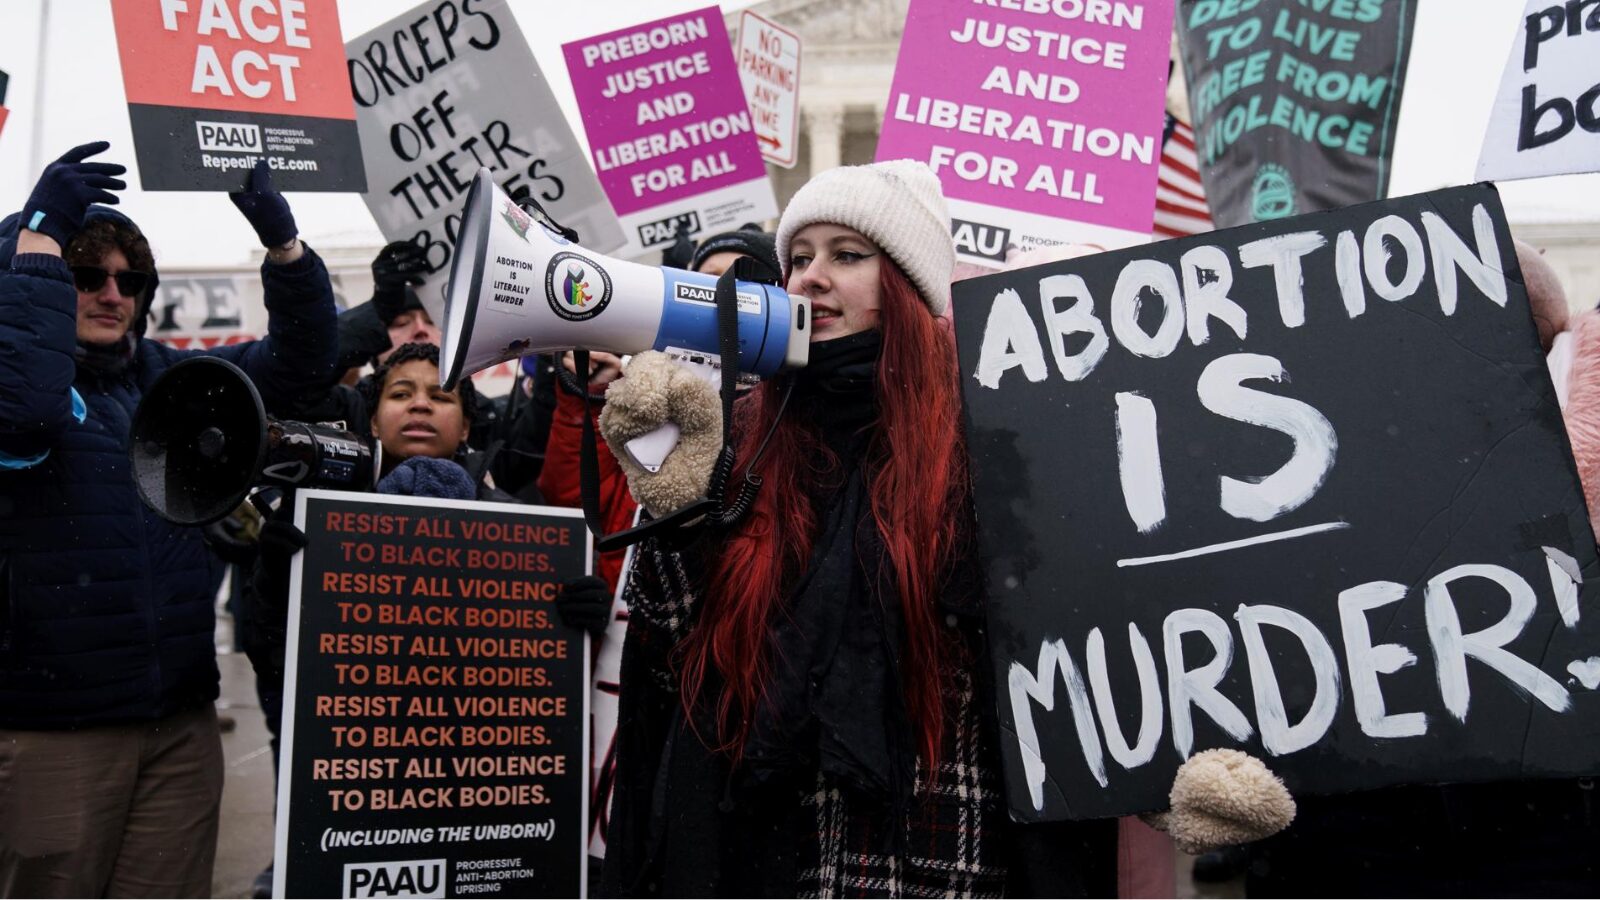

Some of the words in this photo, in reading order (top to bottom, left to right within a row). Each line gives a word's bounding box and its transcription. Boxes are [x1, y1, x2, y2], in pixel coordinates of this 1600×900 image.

[160, 0, 312, 49] FACE
[1206, 17, 1262, 61] TO
[1272, 8, 1362, 61] LIVE
[582, 17, 709, 68] PREBORN
[758, 29, 782, 58] NO
[950, 18, 1127, 70] JUSTICE
[190, 44, 302, 102] ACT
[601, 52, 711, 98] JUSTICE
[743, 48, 794, 92] PARKING
[981, 65, 1080, 104] AND
[1276, 52, 1388, 110] FROM
[637, 92, 695, 126] AND
[754, 84, 781, 108] ANY
[390, 89, 457, 163] OFF
[751, 103, 780, 131] TIME
[893, 93, 1155, 165] LIBERATION
[1205, 93, 1375, 167] VIOLENCE
[201, 126, 257, 148] PAAU
[595, 111, 751, 171] LIBERATION
[201, 154, 318, 173] RepealFCE.com
[631, 163, 687, 198] FOR
[691, 151, 737, 183] ALL
[928, 145, 1019, 188] FOR
[1025, 165, 1104, 205] ALL
[496, 255, 533, 271] ABORTION
[509, 271, 517, 280] IS
[493, 280, 530, 295] LITERALLY
[494, 293, 524, 306] MURDER
[680, 286, 716, 302] PAAU
[974, 202, 1508, 390] ABORTION
[1115, 352, 1339, 534] IS
[325, 511, 409, 537] RESIST
[415, 518, 455, 540] ALL
[459, 521, 570, 546] VIOLENCE
[341, 542, 375, 564] TO
[381, 545, 461, 568] BLACK
[467, 550, 555, 573] BODIES.
[323, 572, 406, 596] RESIST
[412, 575, 453, 598] ALL
[458, 578, 564, 602] VIOLENC
[337, 603, 372, 624] TO
[379, 604, 459, 626] BLACK
[465, 608, 554, 630] BODIES.
[319, 633, 404, 655] RESIST
[409, 636, 450, 657] ALL
[456, 638, 567, 659] VIOLENCE
[334, 664, 369, 685] TO
[376, 665, 458, 686] BLACK
[463, 667, 552, 687] BODIES.
[1008, 545, 1600, 812] MURDER!
[316, 695, 402, 717] RESIST
[407, 697, 448, 717] ALL
[454, 697, 567, 717] VIOLENCE
[331, 727, 367, 747] TO
[373, 727, 455, 747] BLACK
[461, 726, 552, 746] BODIES.
[313, 758, 399, 781] RESIST
[404, 758, 446, 779] ALL
[452, 756, 566, 777] VIOLENCE
[328, 790, 364, 812] TO
[371, 788, 453, 810] BLACK
[459, 785, 551, 808] BODIES.
[320, 827, 433, 851] (INCLUDING
[438, 826, 471, 842] THE
[474, 818, 556, 842] UNBORN)
[456, 857, 522, 871] PROGRESSIVE
[456, 868, 535, 883] ANTI-ABORTION
[349, 863, 440, 899] PAAU
[455, 881, 502, 895] UPRISING
